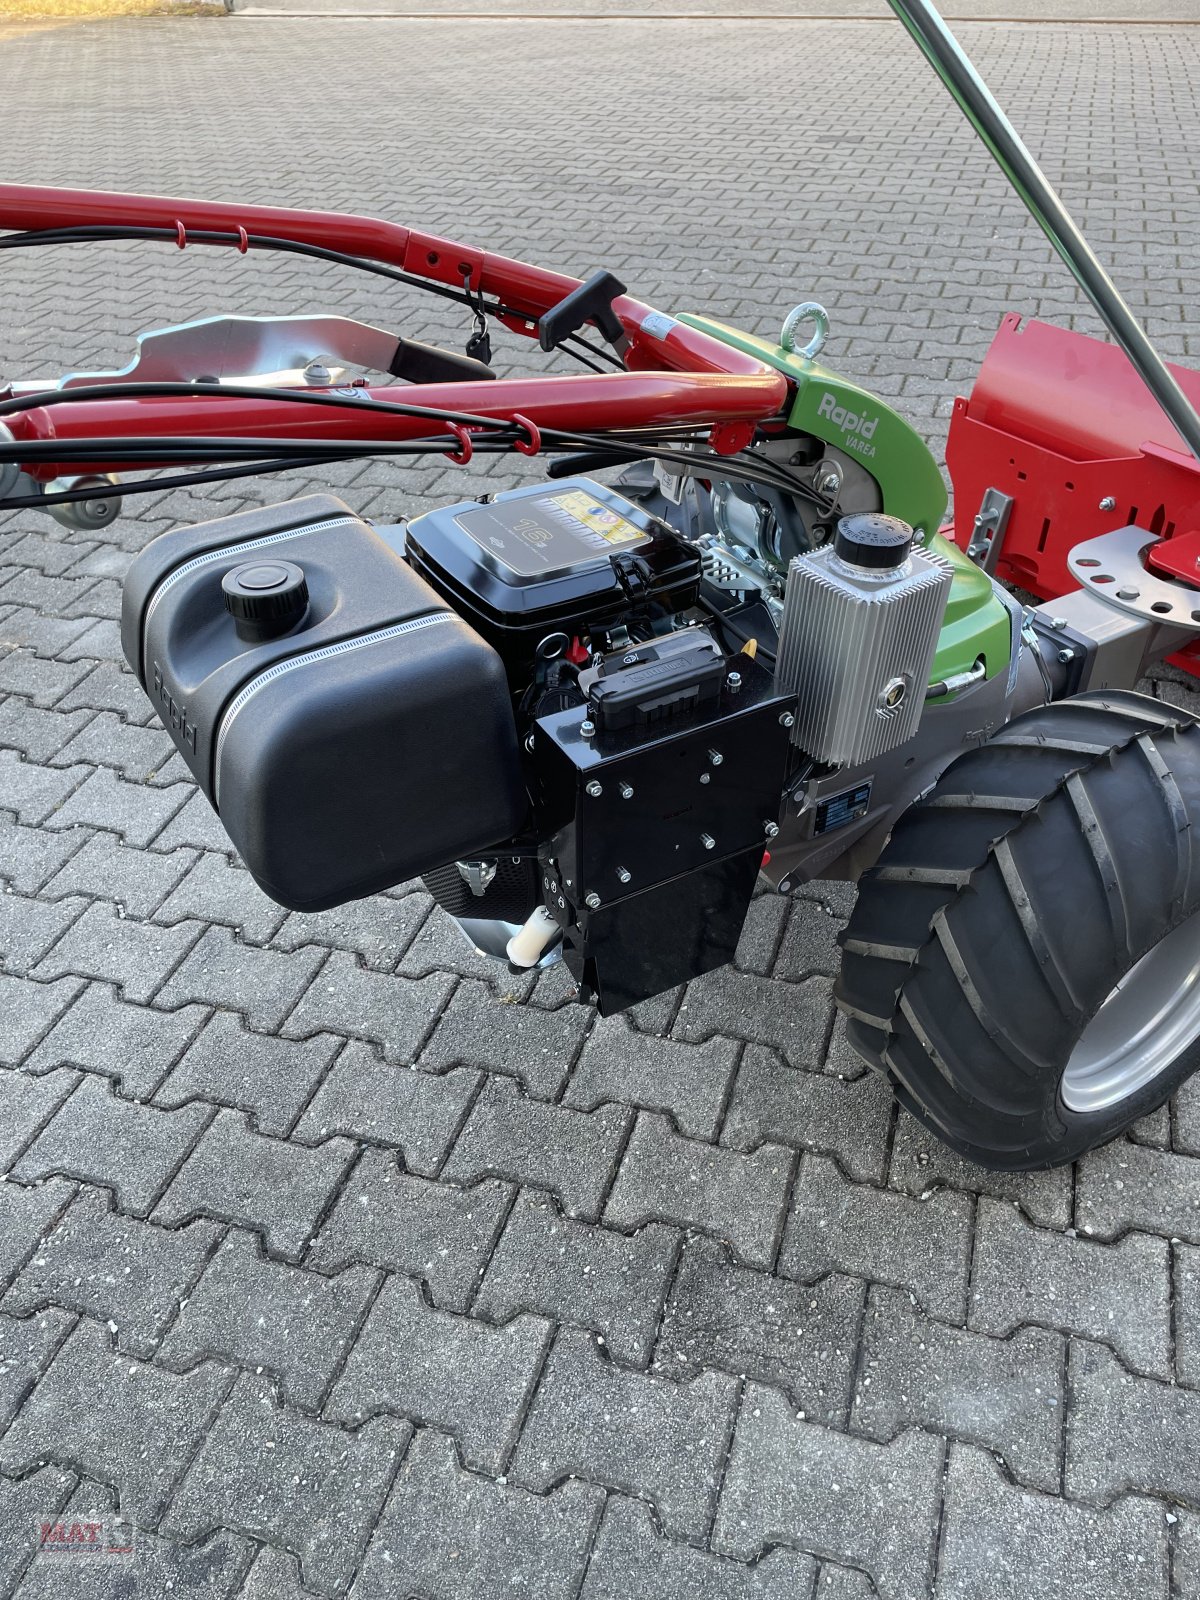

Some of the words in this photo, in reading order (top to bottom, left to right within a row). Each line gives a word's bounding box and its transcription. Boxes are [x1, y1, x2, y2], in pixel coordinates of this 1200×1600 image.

[817, 392, 880, 440] Rapid
[845, 435, 876, 458] VAREA
[512, 518, 554, 546] 16
[153, 660, 197, 755] Rapid
